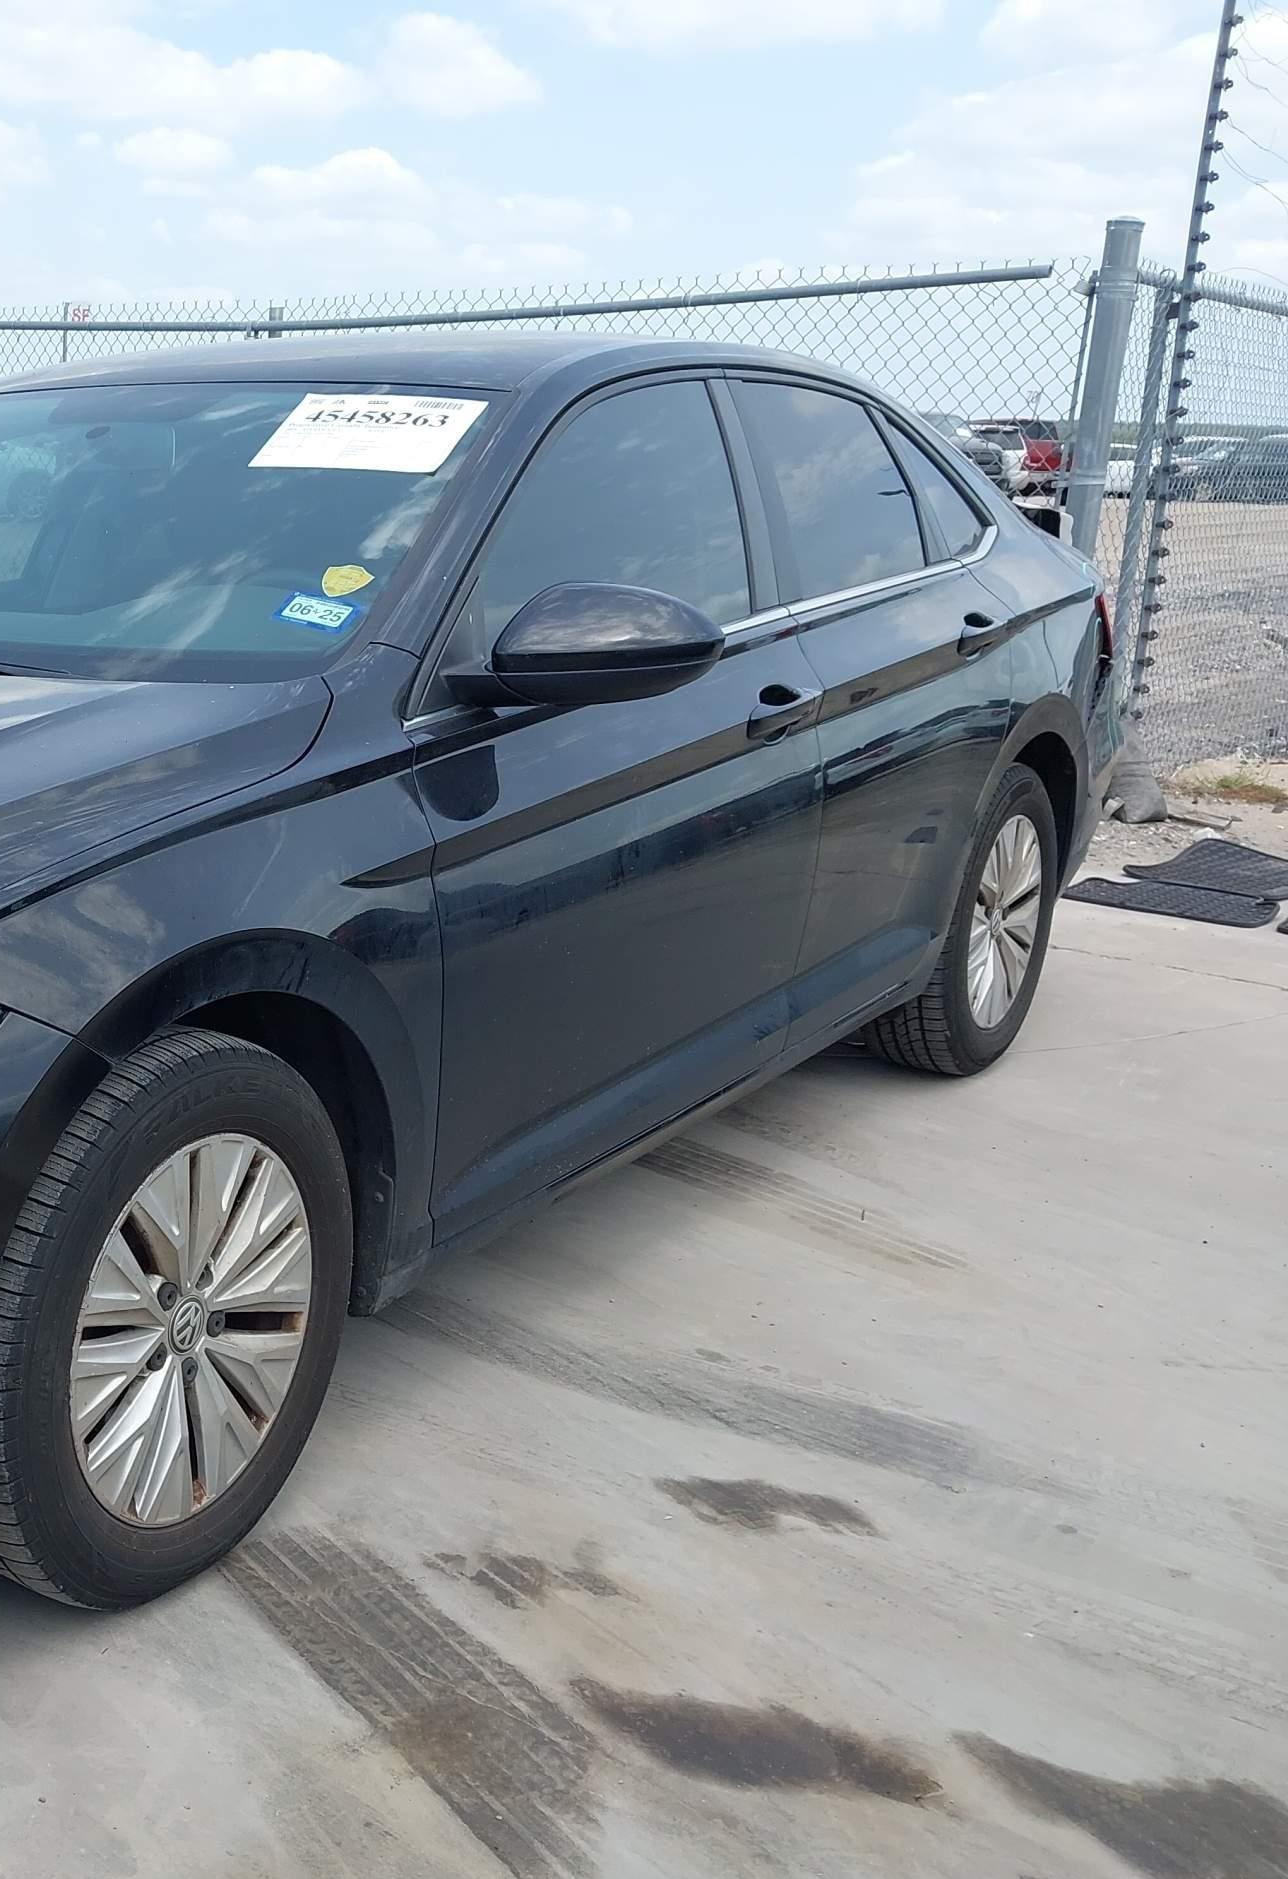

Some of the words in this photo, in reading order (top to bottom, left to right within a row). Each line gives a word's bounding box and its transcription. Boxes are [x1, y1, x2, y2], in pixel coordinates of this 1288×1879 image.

[305, 408, 450, 428] 45458263
[289, 602, 314, 616] 06
[318, 609, 345, 623] 25
